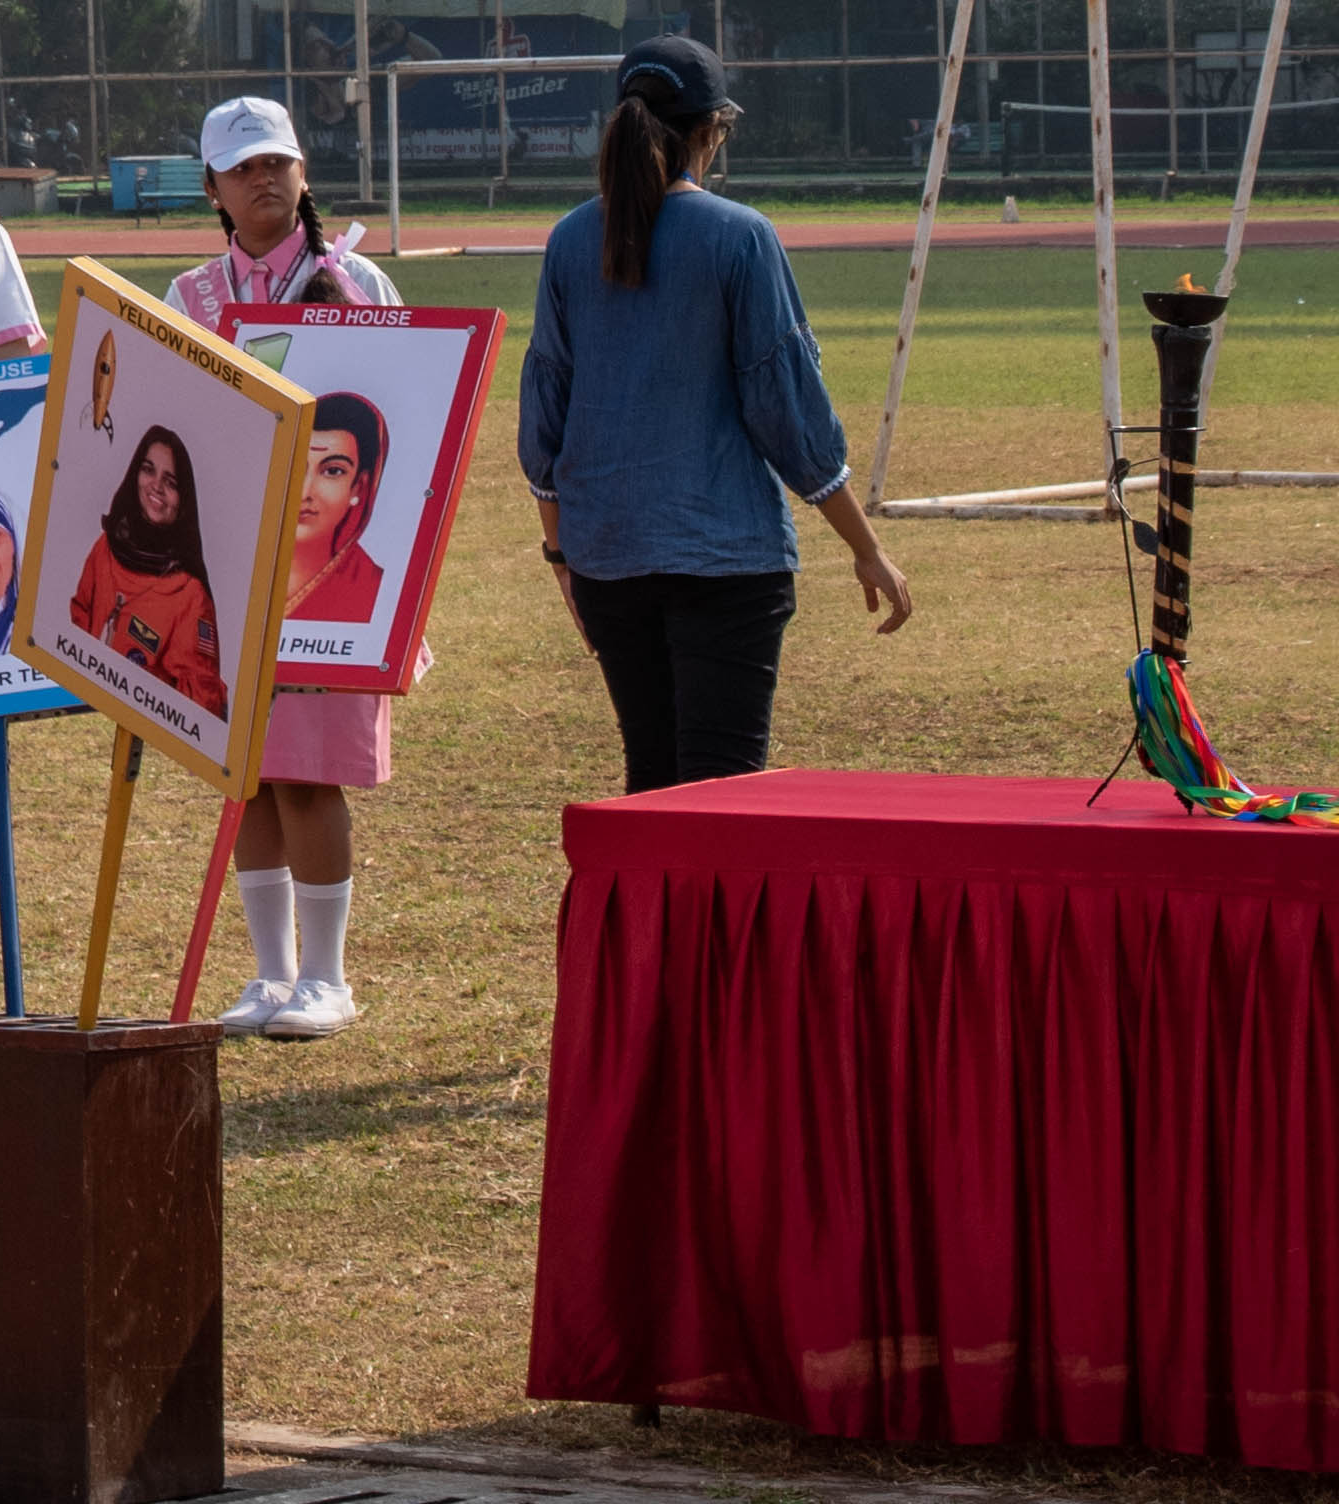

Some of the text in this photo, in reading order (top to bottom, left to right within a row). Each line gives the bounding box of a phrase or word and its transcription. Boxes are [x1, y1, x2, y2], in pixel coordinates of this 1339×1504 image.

[301, 308, 412, 326] RED HOUSE
[117, 299, 243, 391] YELLOW HOUSE
[289, 637, 355, 656] PHULE
[56, 634, 201, 742] KALPANA CHAWLA
